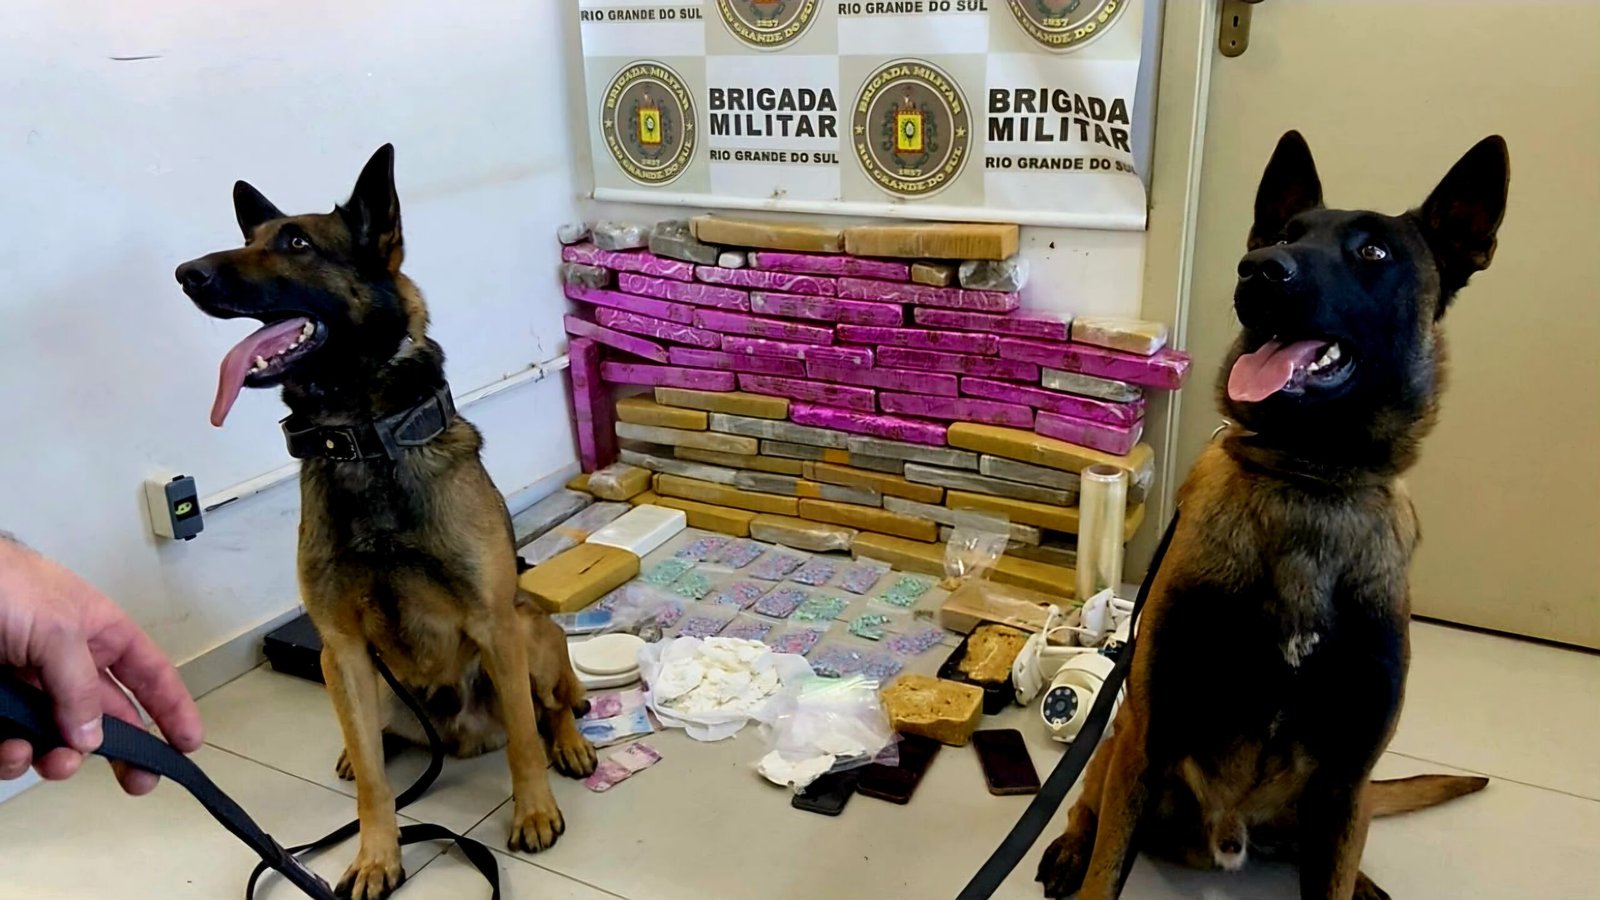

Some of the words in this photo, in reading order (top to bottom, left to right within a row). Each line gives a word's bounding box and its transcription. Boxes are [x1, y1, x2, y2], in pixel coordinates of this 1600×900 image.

[580, 10, 604, 21] RIO
[608, 9, 655, 21] GRANDE
[660, 8, 676, 20] DO
[680, 8, 703, 19] SUL
[838, 3, 861, 15] RIO
[865, 2, 923, 14] GRANDE
[929, 1, 951, 12] DO
[956, 0, 988, 11] SUL
[733, 22, 783, 42] GRANDE
[784, 22, 800, 37] DO
[1075, 22, 1096, 38] DO
[607, 66, 647, 109] BRIGADA
[650, 66, 689, 111] MILITAR
[859, 66, 910, 113] BRIGADA
[913, 66, 961, 114] MILITAR
[708, 88, 837, 111] BRIGADA
[989, 88, 1130, 125] BRIGADA
[710, 113, 838, 137] MILITAR
[988, 117, 1131, 153] MILITAR
[710, 150, 731, 161] RIO
[735, 151, 787, 162] GRANDE
[791, 153, 809, 162] DO
[813, 153, 839, 164] SUL
[985, 157, 1012, 168] RIO
[1017, 157, 1084, 170] GRANDE
[1089, 158, 1111, 170] DO
[622, 160, 664, 179] GRANDE
[664, 163, 678, 176] DO
[873, 170, 927, 191] GRANDE
[928, 173, 945, 187] DO
[945, 146, 962, 174] SUL
